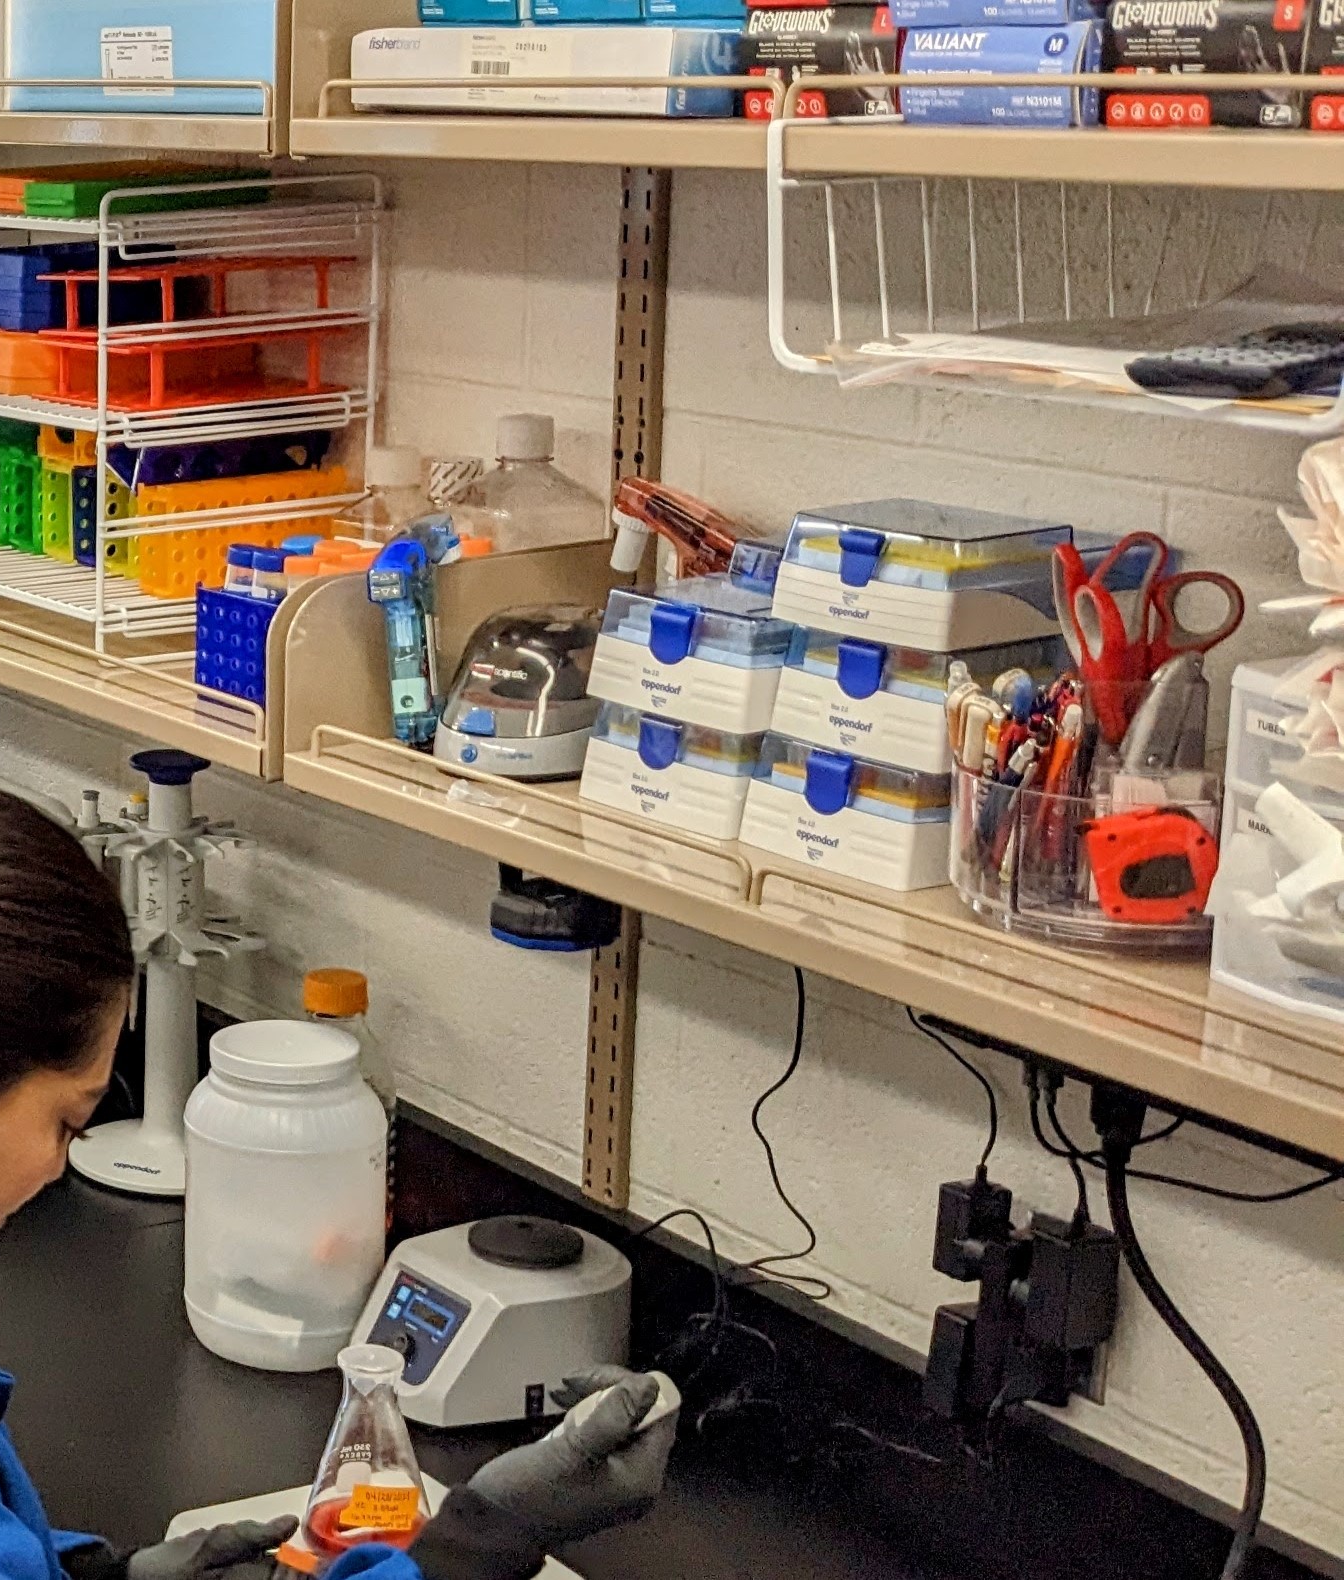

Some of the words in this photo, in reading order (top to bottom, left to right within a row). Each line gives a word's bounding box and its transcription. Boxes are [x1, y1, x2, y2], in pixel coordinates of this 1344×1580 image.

[748, 8, 833, 34] GLOVEWORKS
[879, 12, 887, 28] L
[1112, 1, 1219, 31] GLOVEWORKS
[1283, 5, 1293, 20] S
[368, 36, 421, 51] fisherbrand
[914, 32, 989, 51] VALIANT
[1048, 38, 1063, 52] M
[992, 108, 1005, 116] 100
[828, 605, 870, 620] eppendorf
[641, 678, 682, 695] eppendorf
[829, 714, 873, 733] eppendorf
[631, 783, 670, 801] eppendorf
[796, 828, 840, 849] eppendorf
